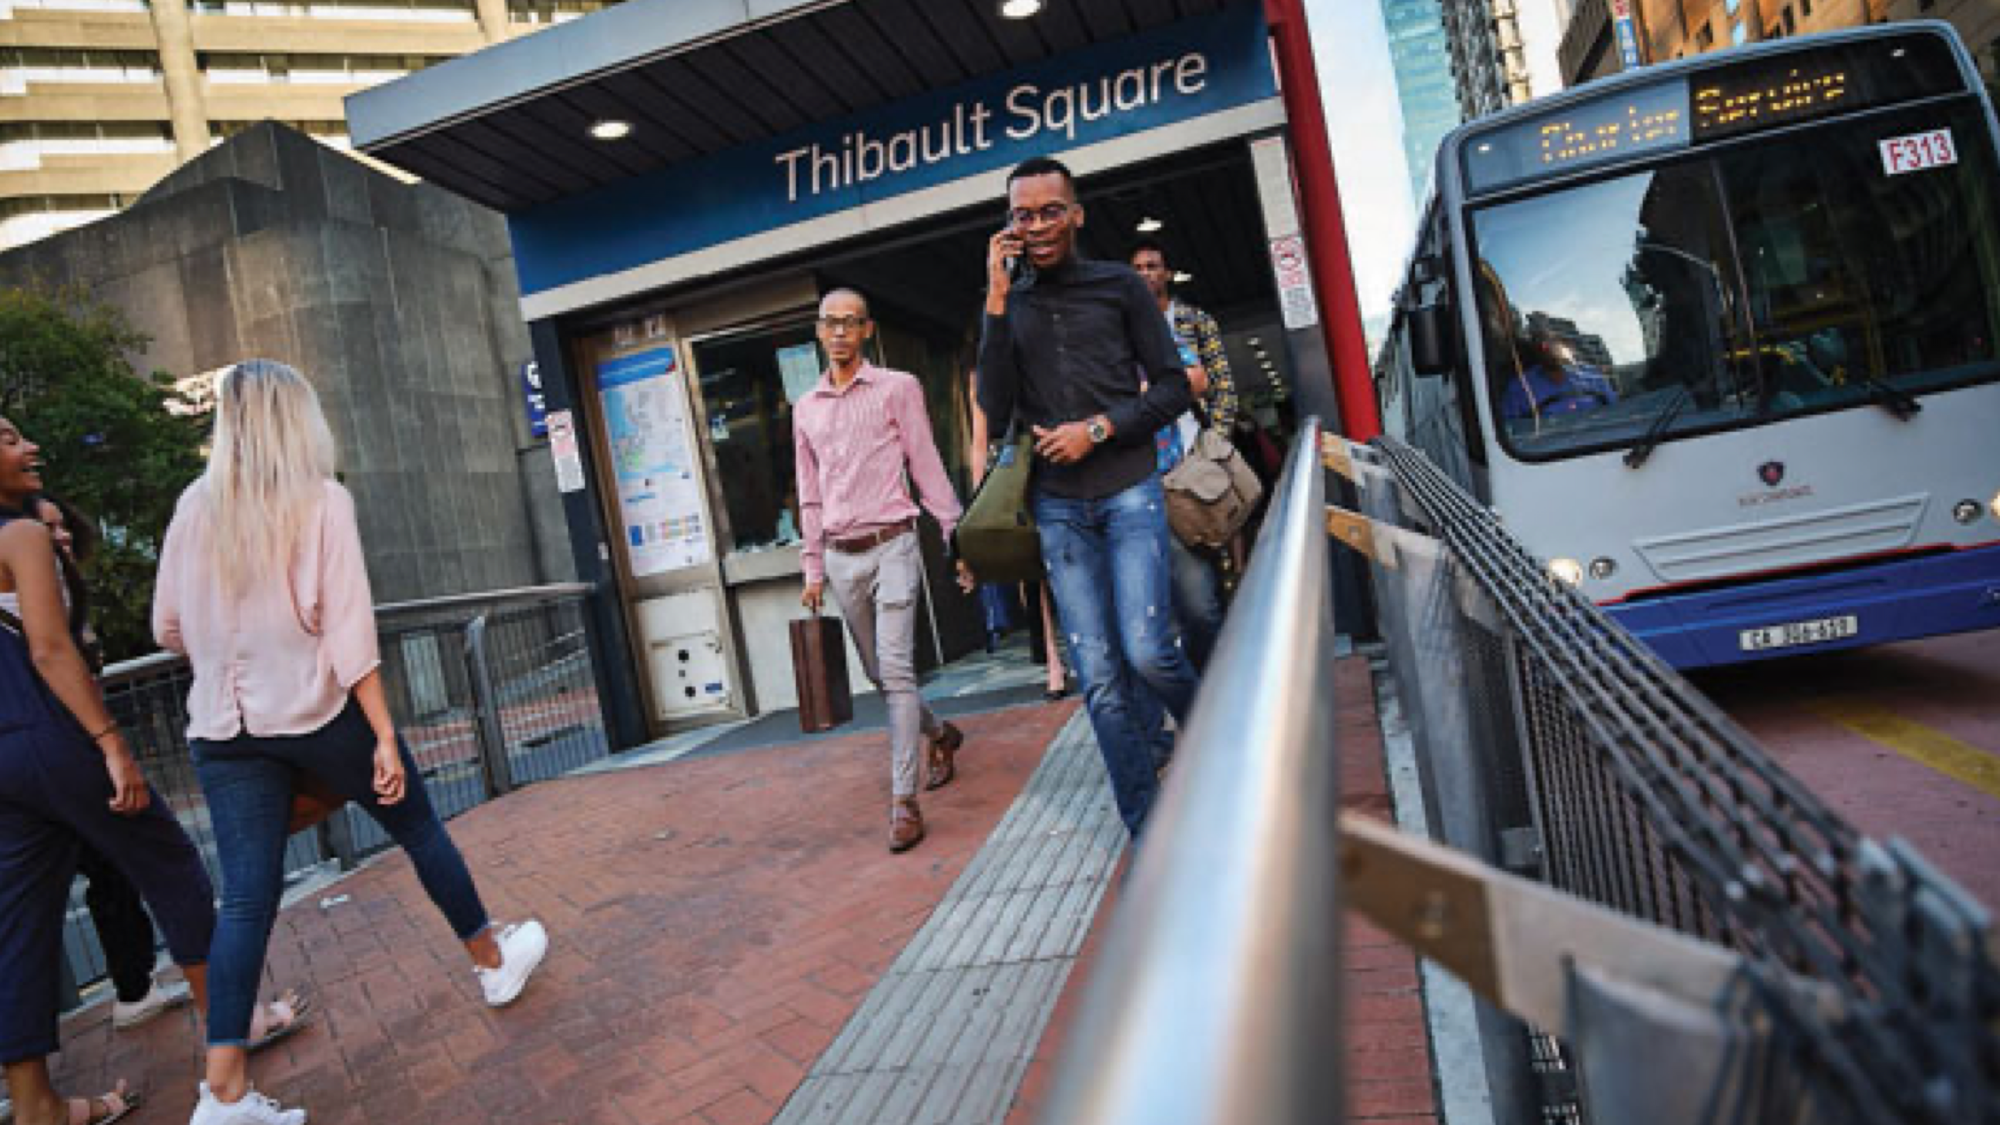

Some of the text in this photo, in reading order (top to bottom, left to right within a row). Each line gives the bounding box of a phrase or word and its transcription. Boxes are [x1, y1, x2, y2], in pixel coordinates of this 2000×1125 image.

[775, 52, 1206, 202] Thibault Square
[1886, 132, 1952, 171] F313
